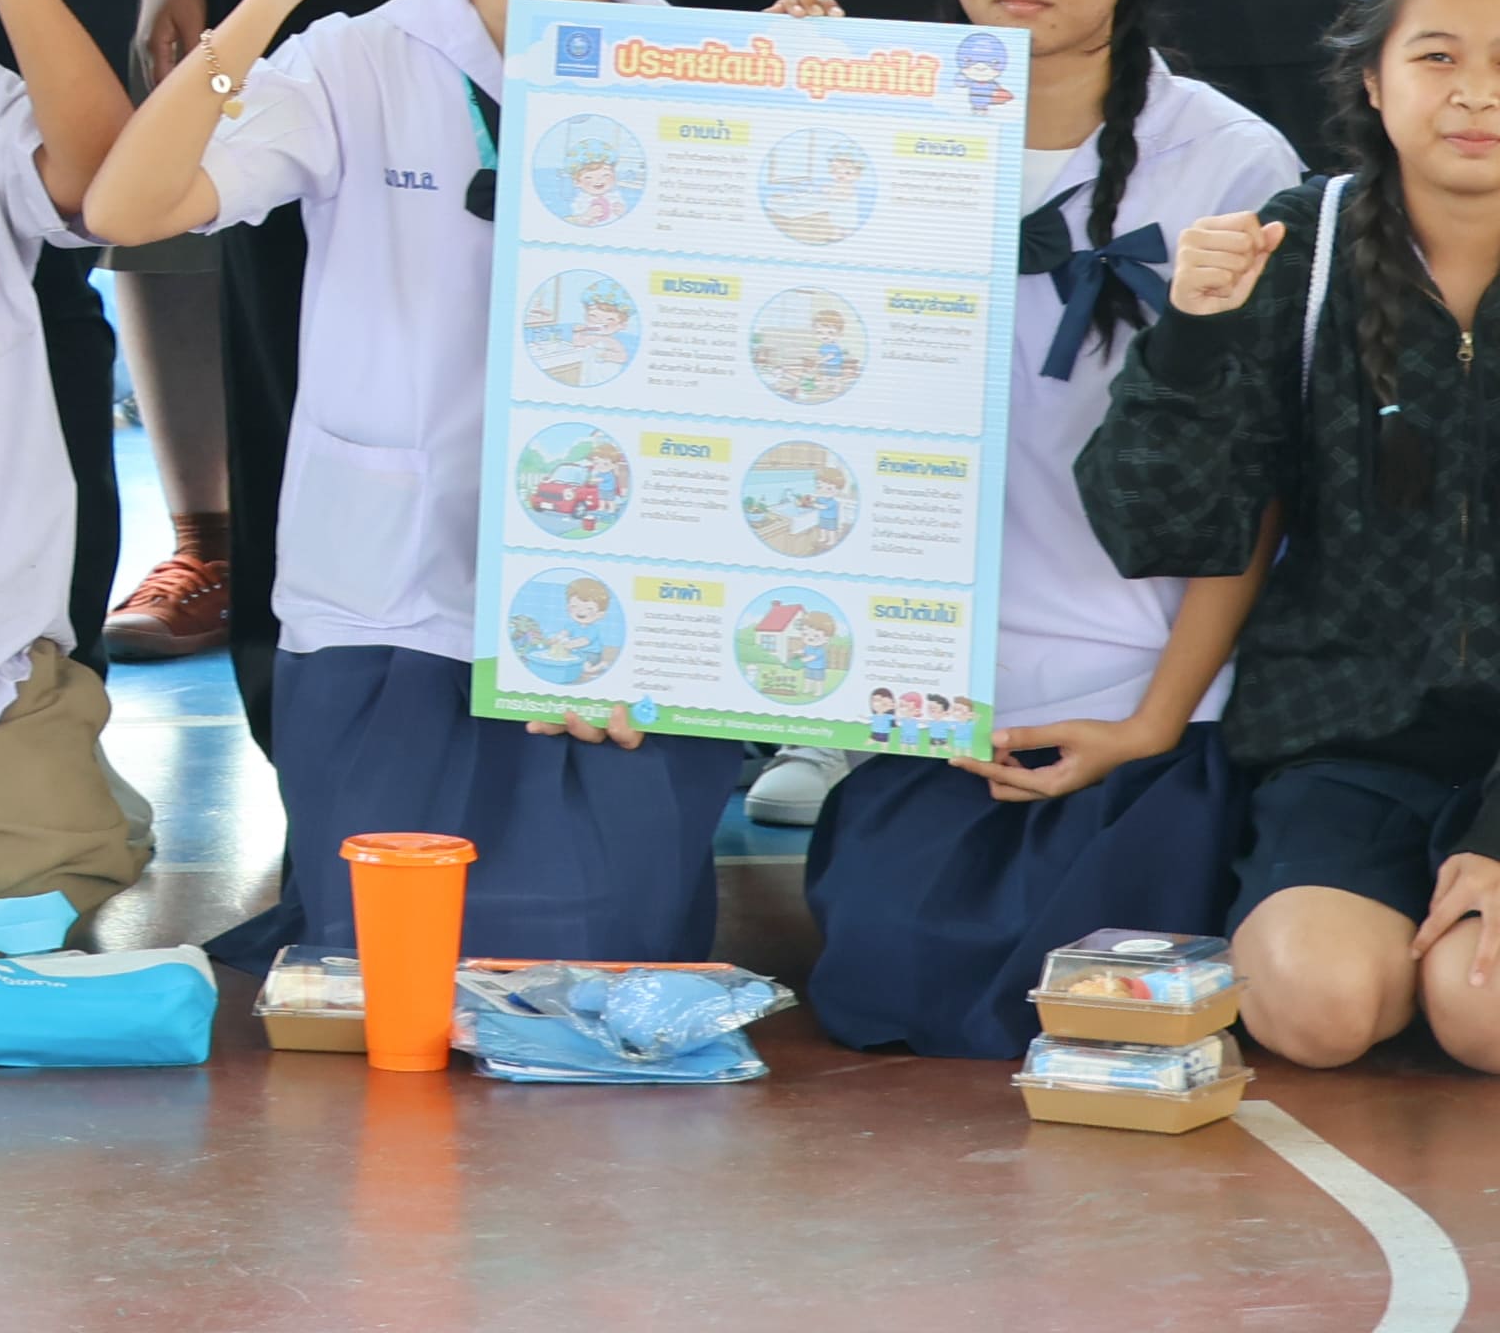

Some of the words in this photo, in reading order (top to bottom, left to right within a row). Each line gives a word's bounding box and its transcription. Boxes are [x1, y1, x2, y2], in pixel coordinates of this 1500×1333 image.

[615, 39, 784, 86] ประหยัดน้ำ
[798, 53, 940, 97] คุณทำได้
[679, 119, 731, 142] อาบน้ำ
[660, 439, 710, 459] ล้างรถ
